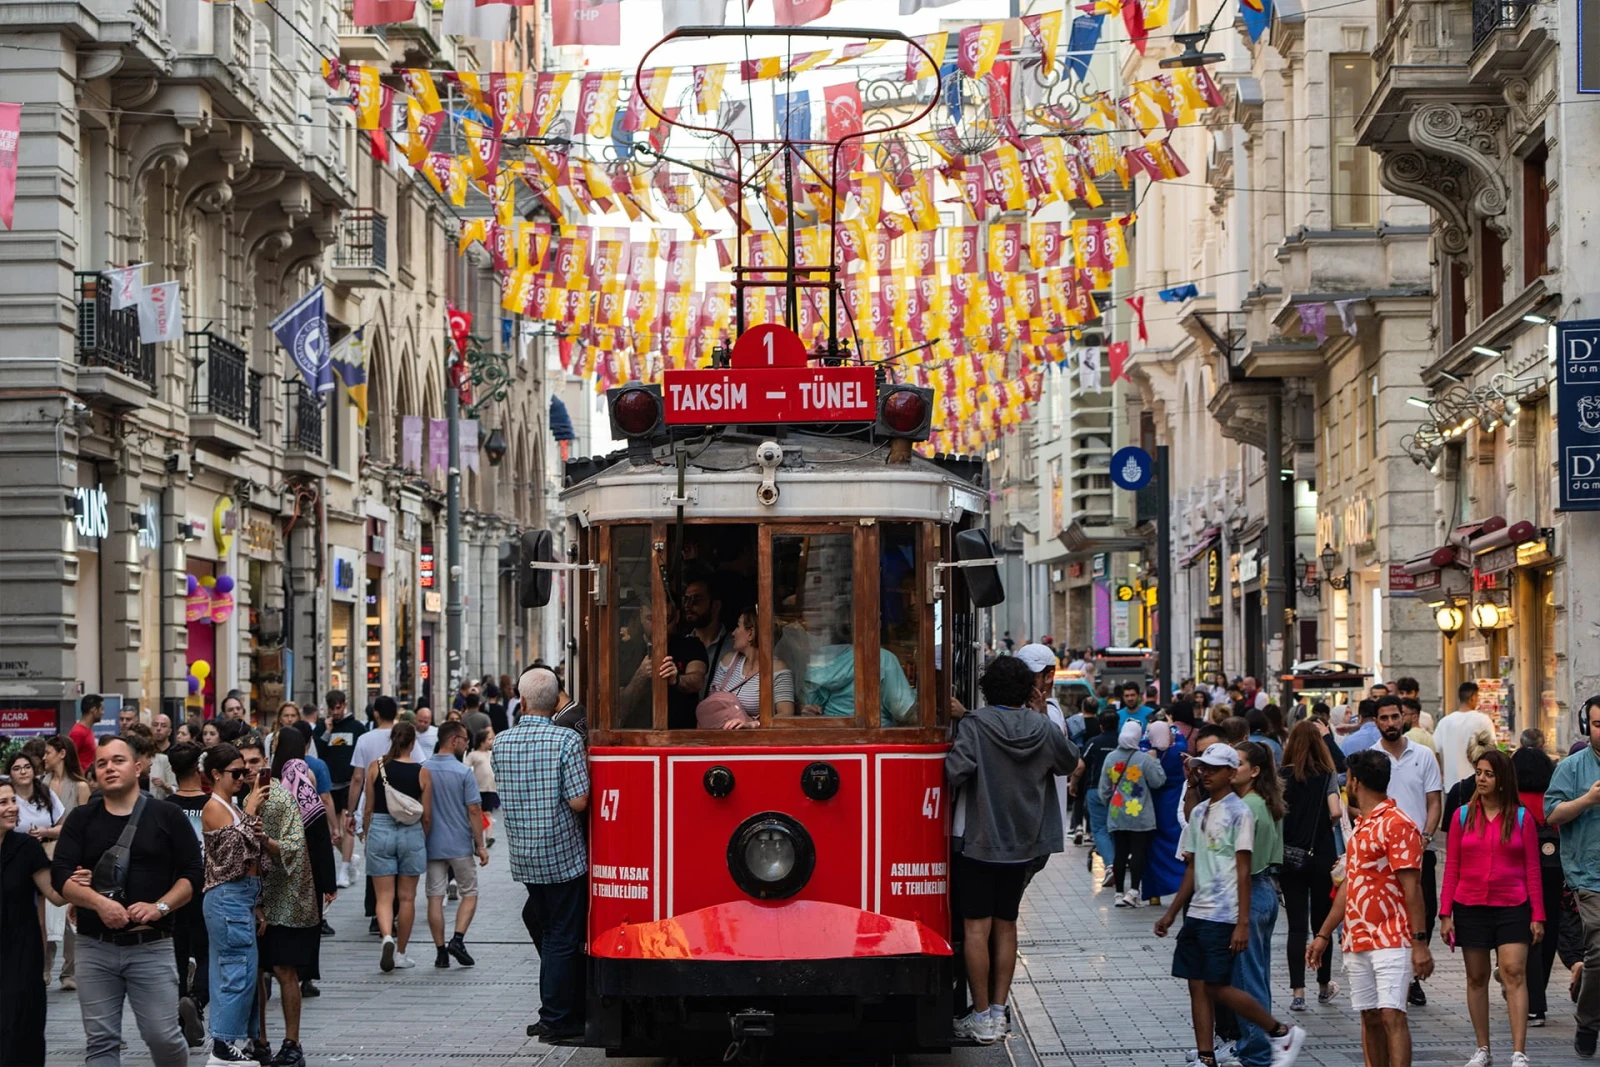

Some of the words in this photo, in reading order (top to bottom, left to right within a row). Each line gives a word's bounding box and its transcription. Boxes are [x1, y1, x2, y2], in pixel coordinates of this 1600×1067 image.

[573, 9, 599, 21] CHP
[913, 242, 929, 260] 23
[954, 241, 970, 260] 23
[995, 240, 1013, 257] 23
[1036, 235, 1053, 252] 23
[1080, 235, 1096, 252] 23
[870, 243, 885, 262] 23
[1020, 289, 1034, 305] 23
[1056, 281, 1071, 297] 23
[157, 303, 168, 335] YILDIZ
[763, 332, 775, 365] 1
[669, 375, 747, 411] TAKSİM
[798, 375, 868, 410] TÜNEL
[2, 713, 28, 721] ACARA
[600, 789, 620, 821] 47
[922, 787, 941, 820] 47
[619, 866, 649, 880] YASAK
[890, 863, 930, 876] ASILMAK
[891, 881, 903, 895] VE
